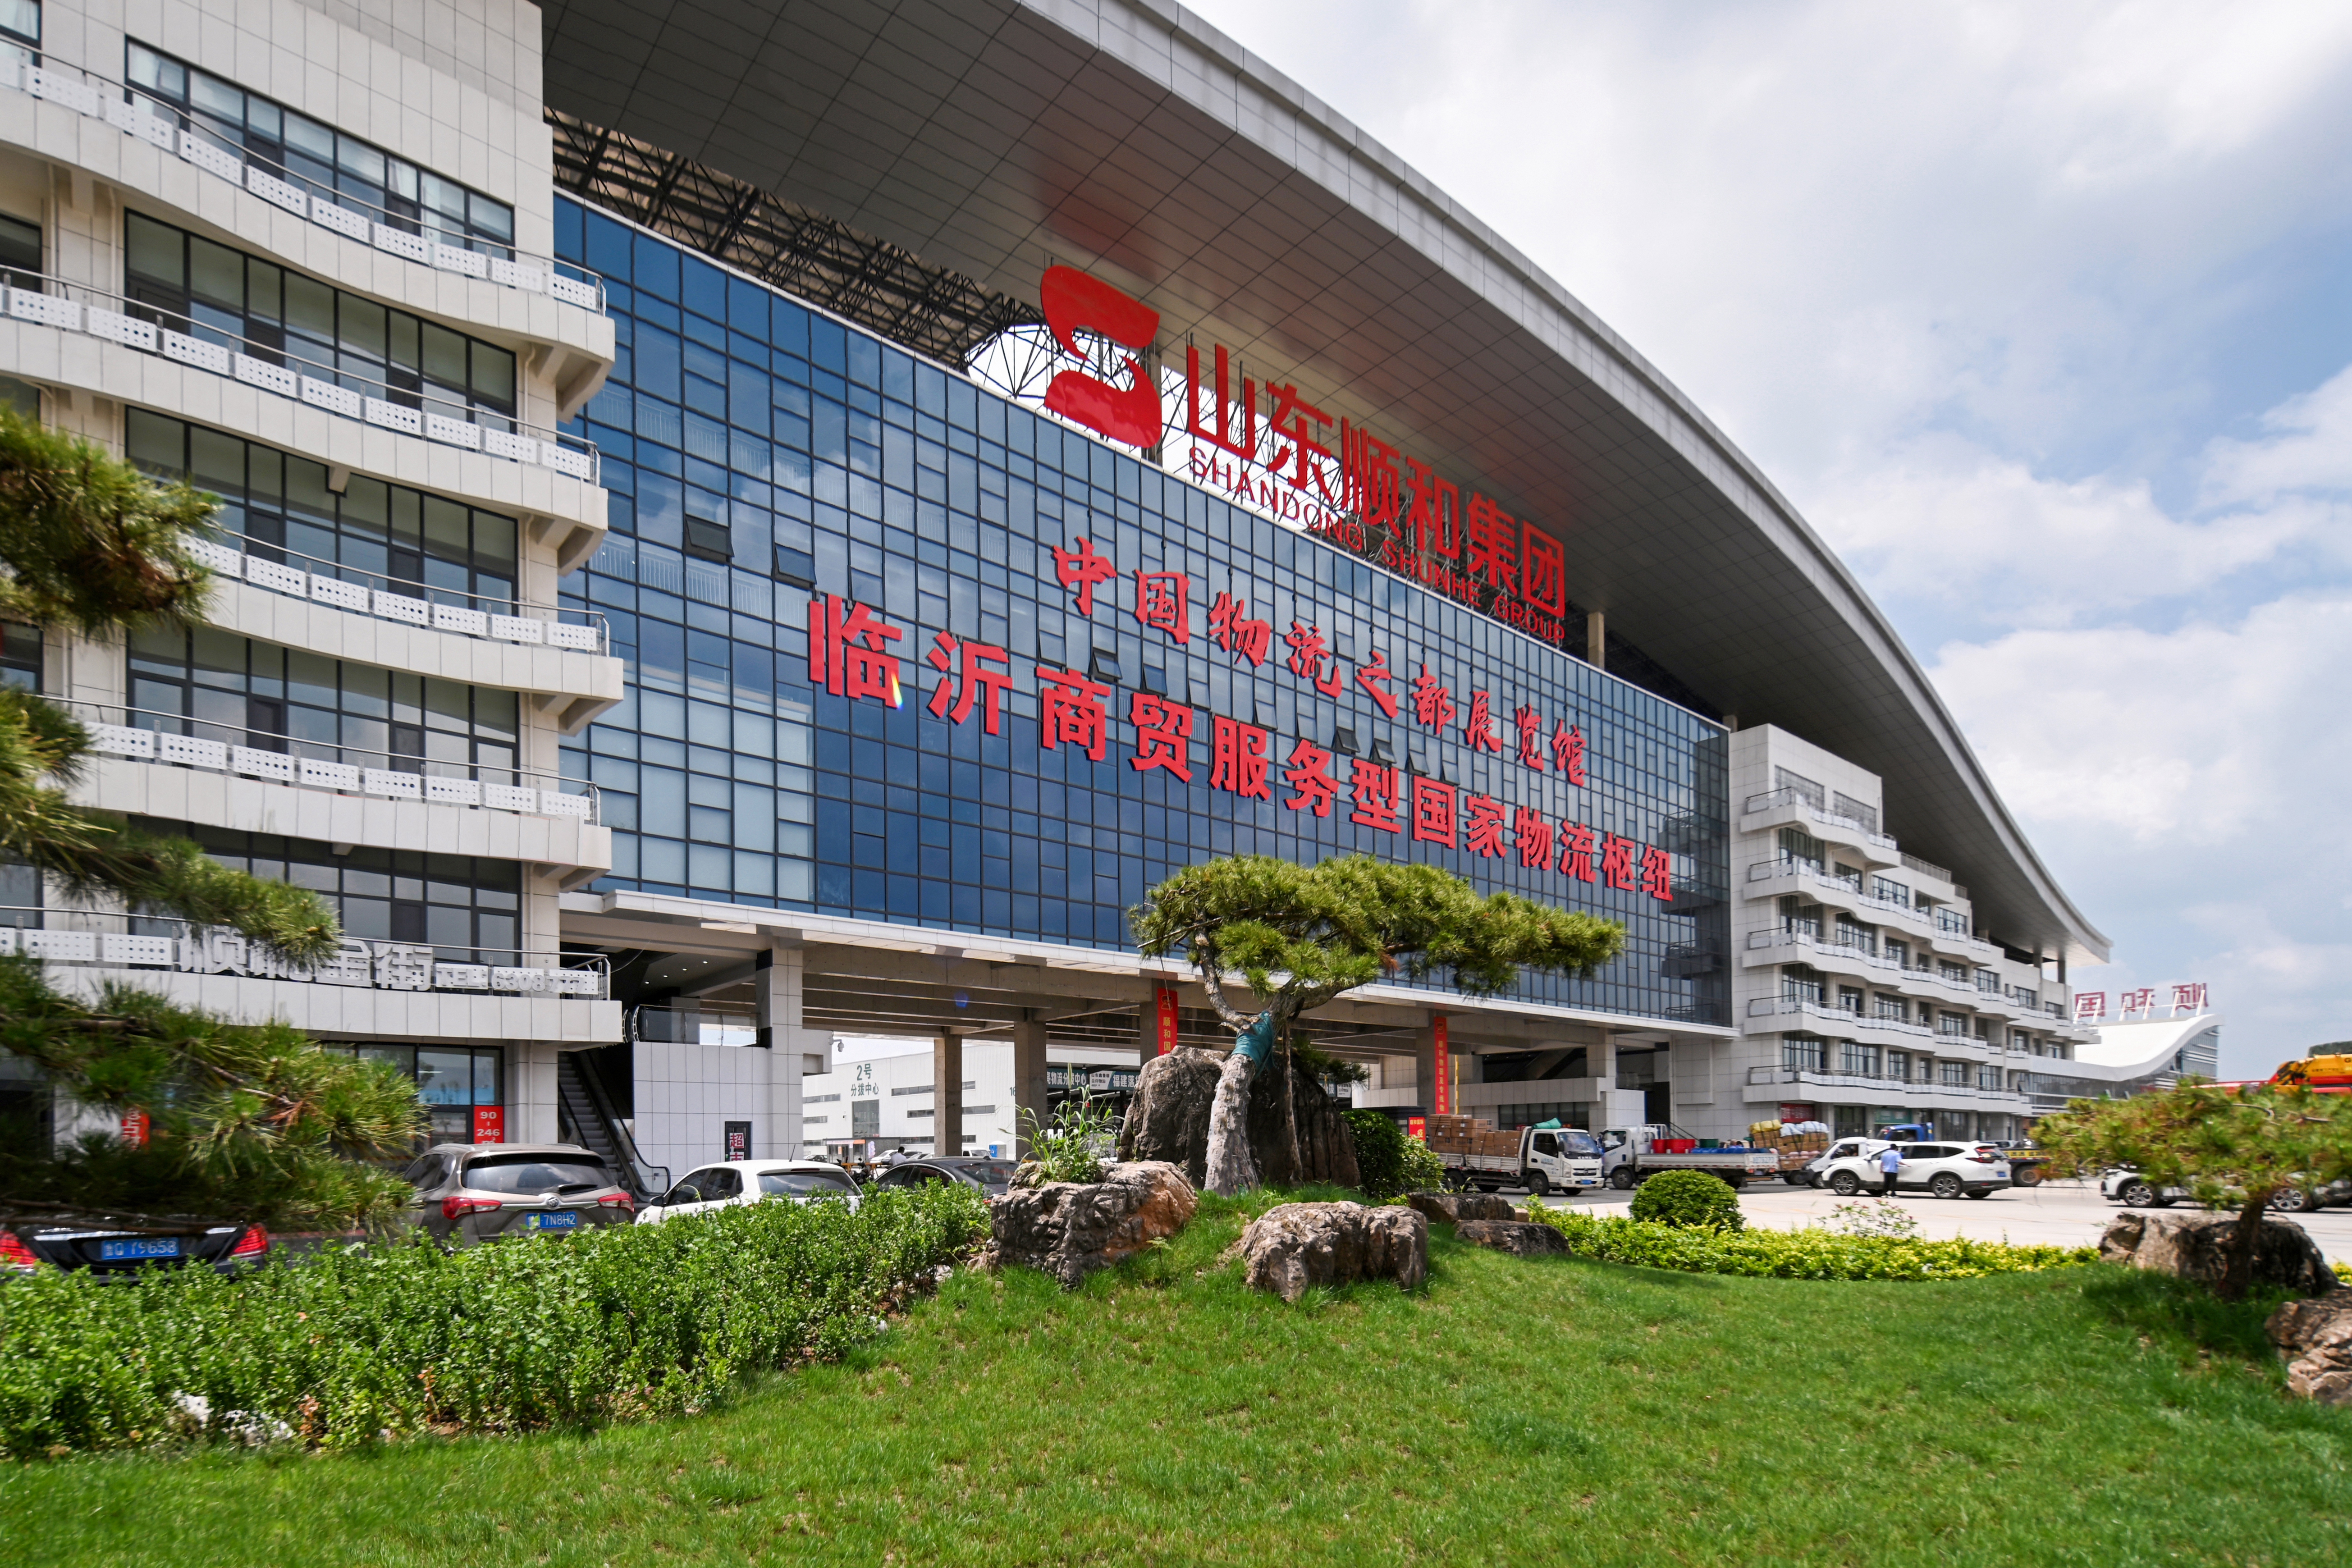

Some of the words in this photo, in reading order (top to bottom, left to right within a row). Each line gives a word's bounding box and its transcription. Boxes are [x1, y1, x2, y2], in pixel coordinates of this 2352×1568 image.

[1186, 342, 1566, 619] 山东顺和集团
[1188, 446, 1363, 551] SHANDONG
[1382, 539, 1481, 607] SHUNHE
[1494, 596, 1565, 645] GROUP
[809, 594, 1673, 901] 临沂商贸服务型国家物流枢纽
[1053, 536, 1587, 787] 中国物流之都展览馆
[851, 1082, 879, 1097] 分拨中心
[857, 1063, 872, 1081] 2号
